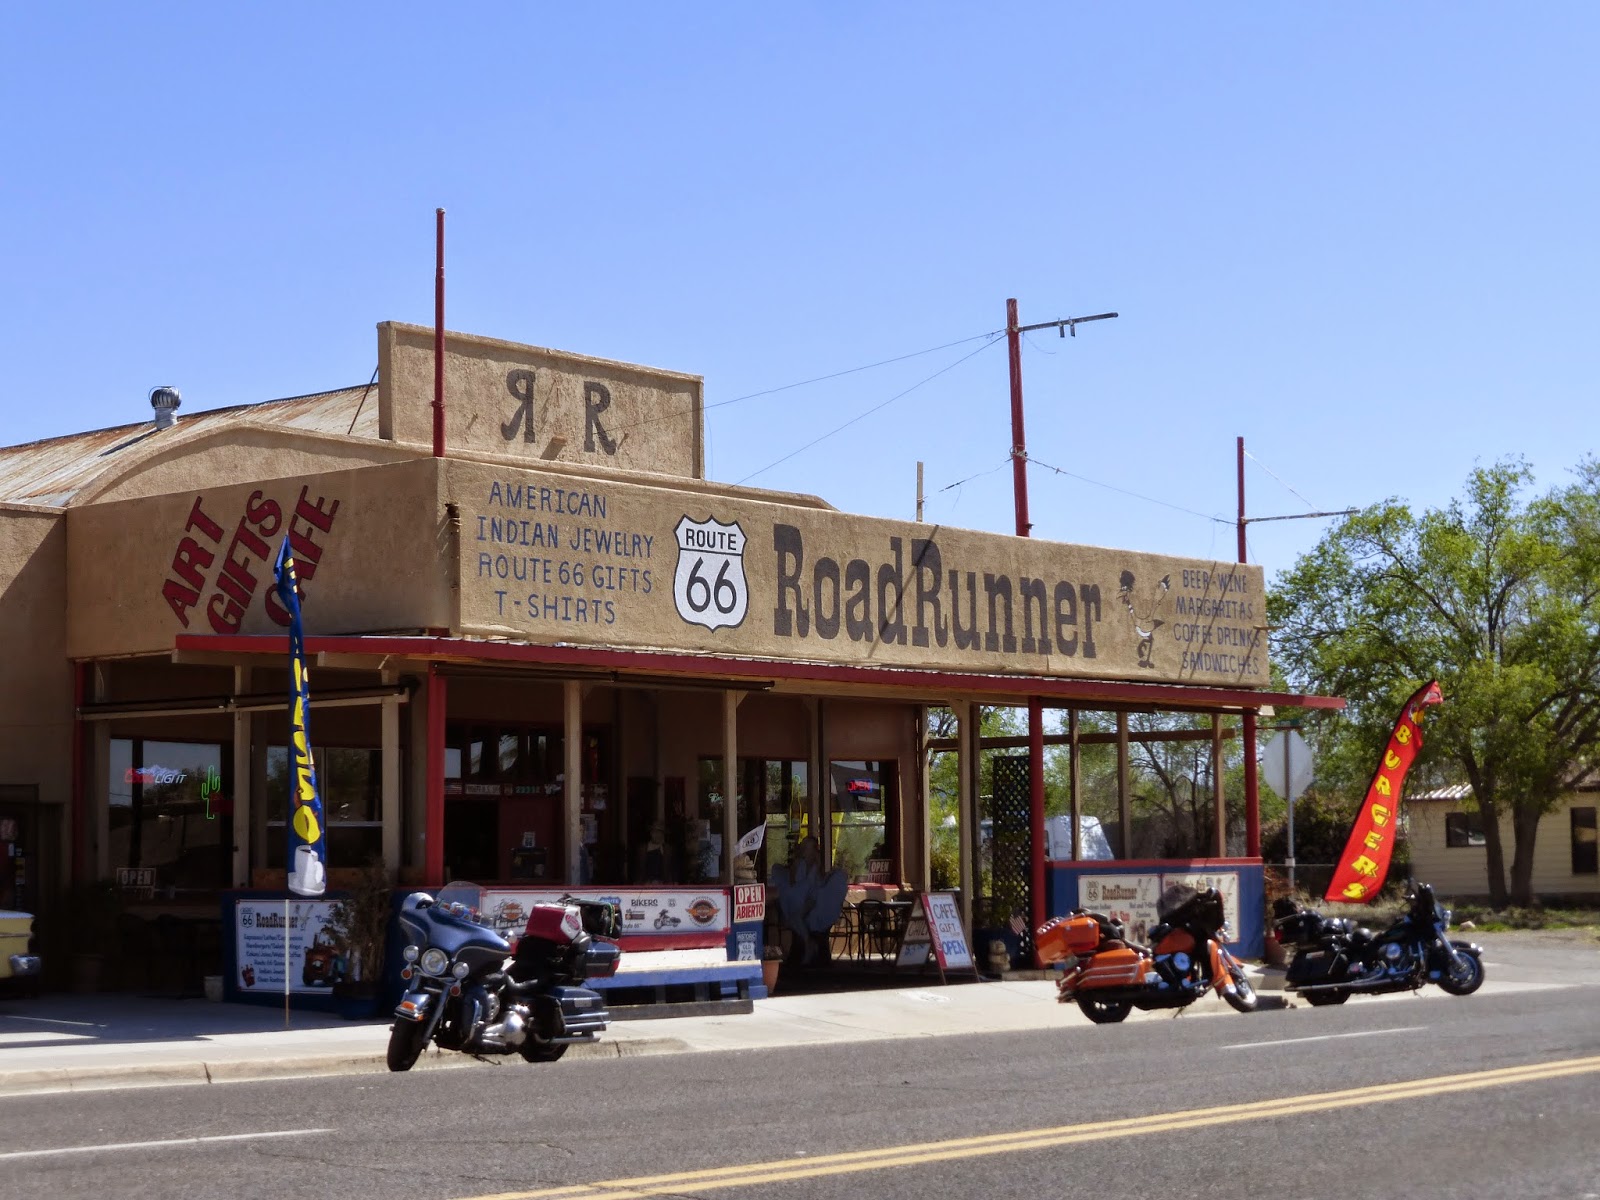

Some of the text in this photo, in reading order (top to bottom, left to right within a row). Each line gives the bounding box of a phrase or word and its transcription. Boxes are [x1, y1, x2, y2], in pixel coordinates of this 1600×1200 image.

[584, 381, 616, 455] R
[489, 481, 606, 518] AMERICAN
[477, 516, 654, 558] INDIAN JEWELRY
[685, 528, 737, 550] ROUTE
[162, 496, 224, 629] ART
[207, 490, 282, 634] GIFTS
[479, 552, 653, 593] ROUTE 66 GIFTS
[686, 557, 737, 614] 66
[774, 524, 1101, 658] RoadRunner
[1217, 573, 1247, 593] WINE
[494, 590, 616, 624] T-SHIRTS
[1176, 596, 1253, 620] MARGARITAS
[1217, 627, 1260, 648] DRINKS
[1182, 651, 1259, 675] SANDWICHES
[1342, 724, 1412, 898] BURGERS
[121, 870, 151, 885] OPEN
[871, 861, 889, 872] OPEN
[631, 899, 658, 907] BIKERS
[738, 886, 762, 903] OPEN
[1088, 889, 1098, 898] 66
[242, 916, 253, 926] 66
[736, 904, 763, 919] ABIERTO
[933, 904, 957, 919] CAFE
[939, 923, 956, 932] GIFT
[942, 940, 966, 955] OPEN
